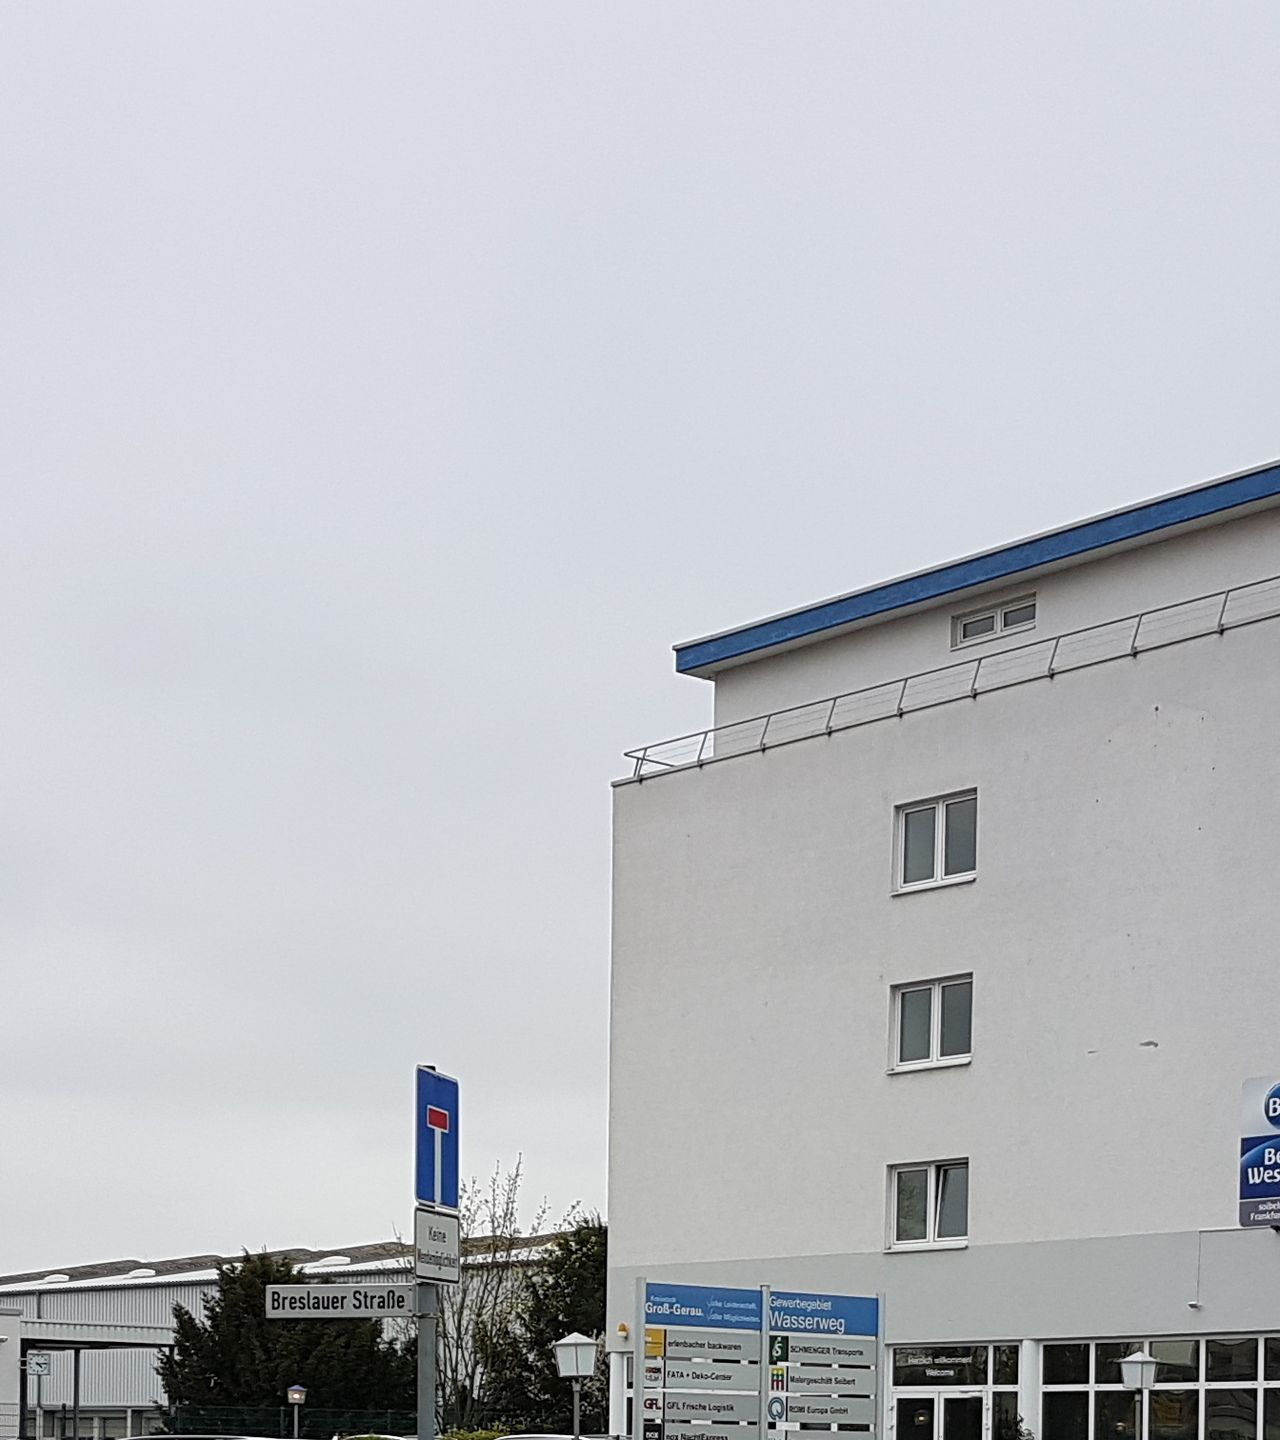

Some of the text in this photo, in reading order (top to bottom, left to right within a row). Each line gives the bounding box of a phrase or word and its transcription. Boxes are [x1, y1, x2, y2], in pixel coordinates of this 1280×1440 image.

[271, 1290, 405, 1310] Breslauer Straße
[769, 1295, 832, 1312] Gewerbegebiet
[769, 1310, 846, 1335] Wasserweg
[643, 1398, 662, 1410] GFL
[666, 1402, 734, 1413] GFL Frische Logistik
